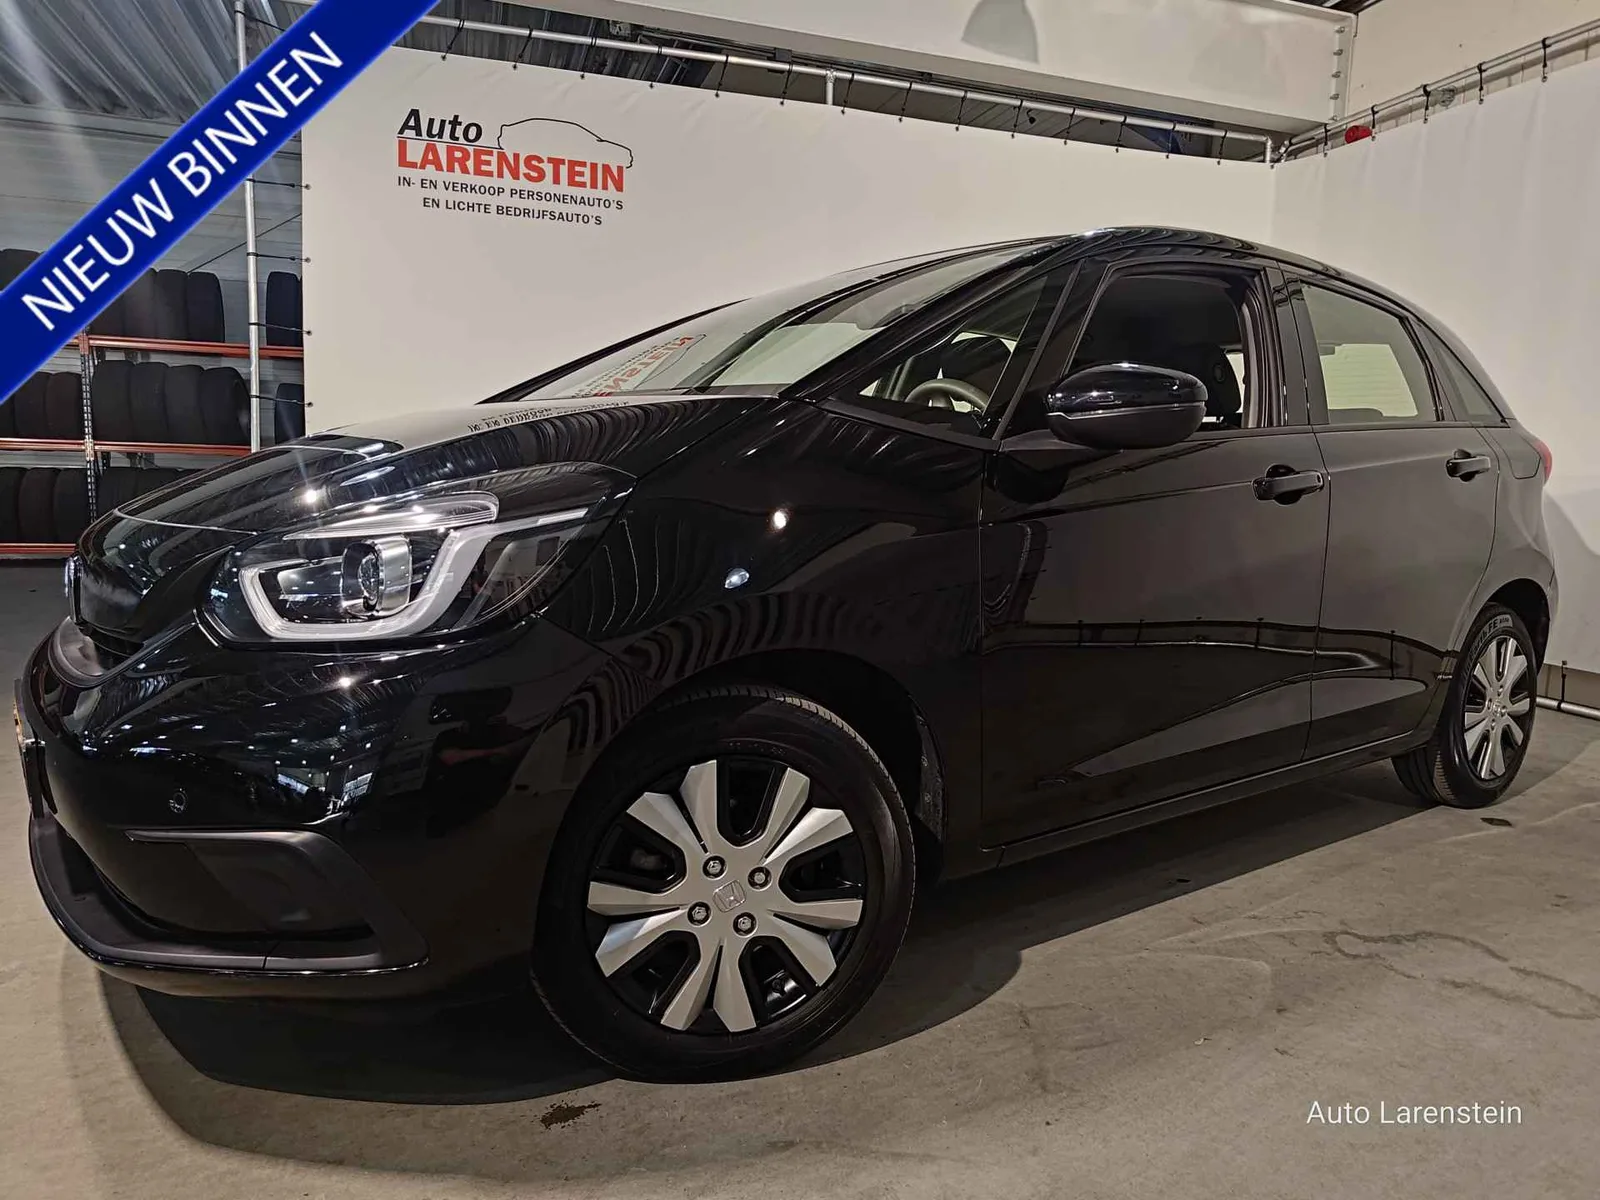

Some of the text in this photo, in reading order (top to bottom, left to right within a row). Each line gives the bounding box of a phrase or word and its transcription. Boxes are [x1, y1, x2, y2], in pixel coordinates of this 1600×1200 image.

[397, 108, 483, 143] Auto
[398, 139, 624, 193] LARENSTEIN
[397, 176, 624, 210] IN- EN VERKOOP PERSONENAUTO'S
[422, 197, 603, 225] EN LICHTE BEDRIJFSAUTO'S
